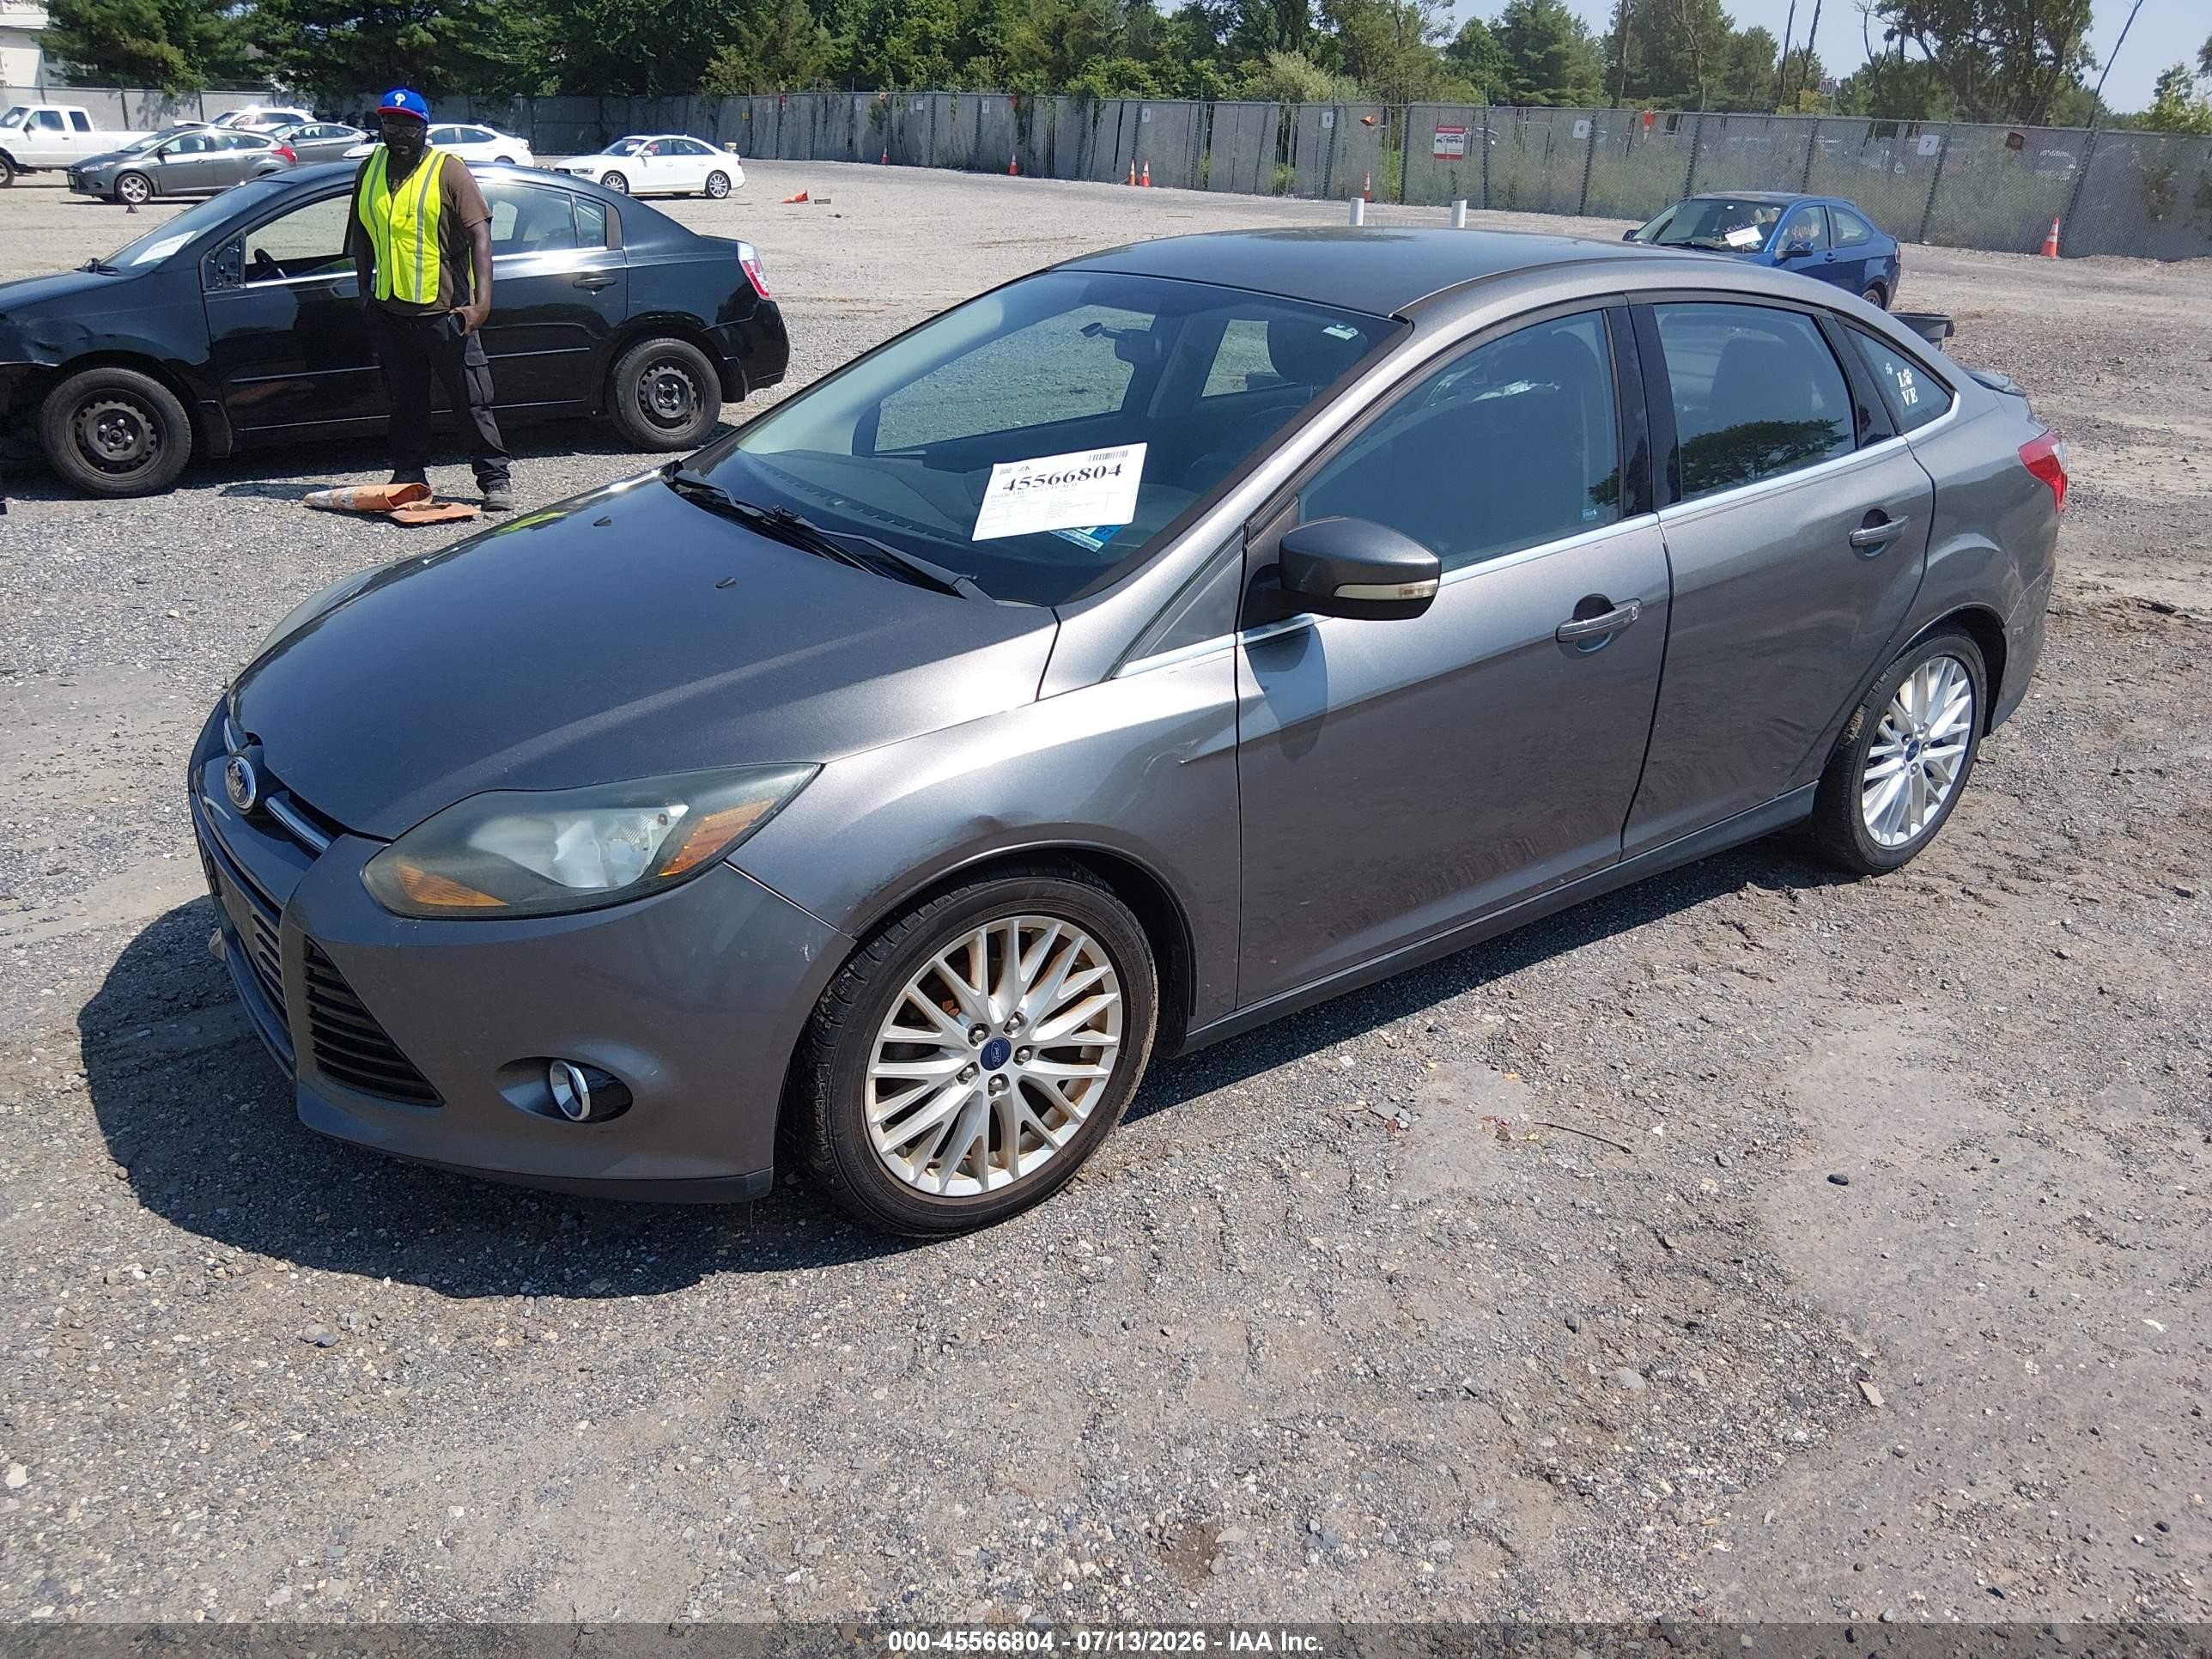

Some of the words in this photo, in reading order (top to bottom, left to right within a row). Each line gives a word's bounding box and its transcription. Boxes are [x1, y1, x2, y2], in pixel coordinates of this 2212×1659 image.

[394, 92, 406, 106] P
[1925, 140, 1932, 149] 7
[1003, 463, 1119, 492] 45566804
[1096, 526, 1114, 536] 27
